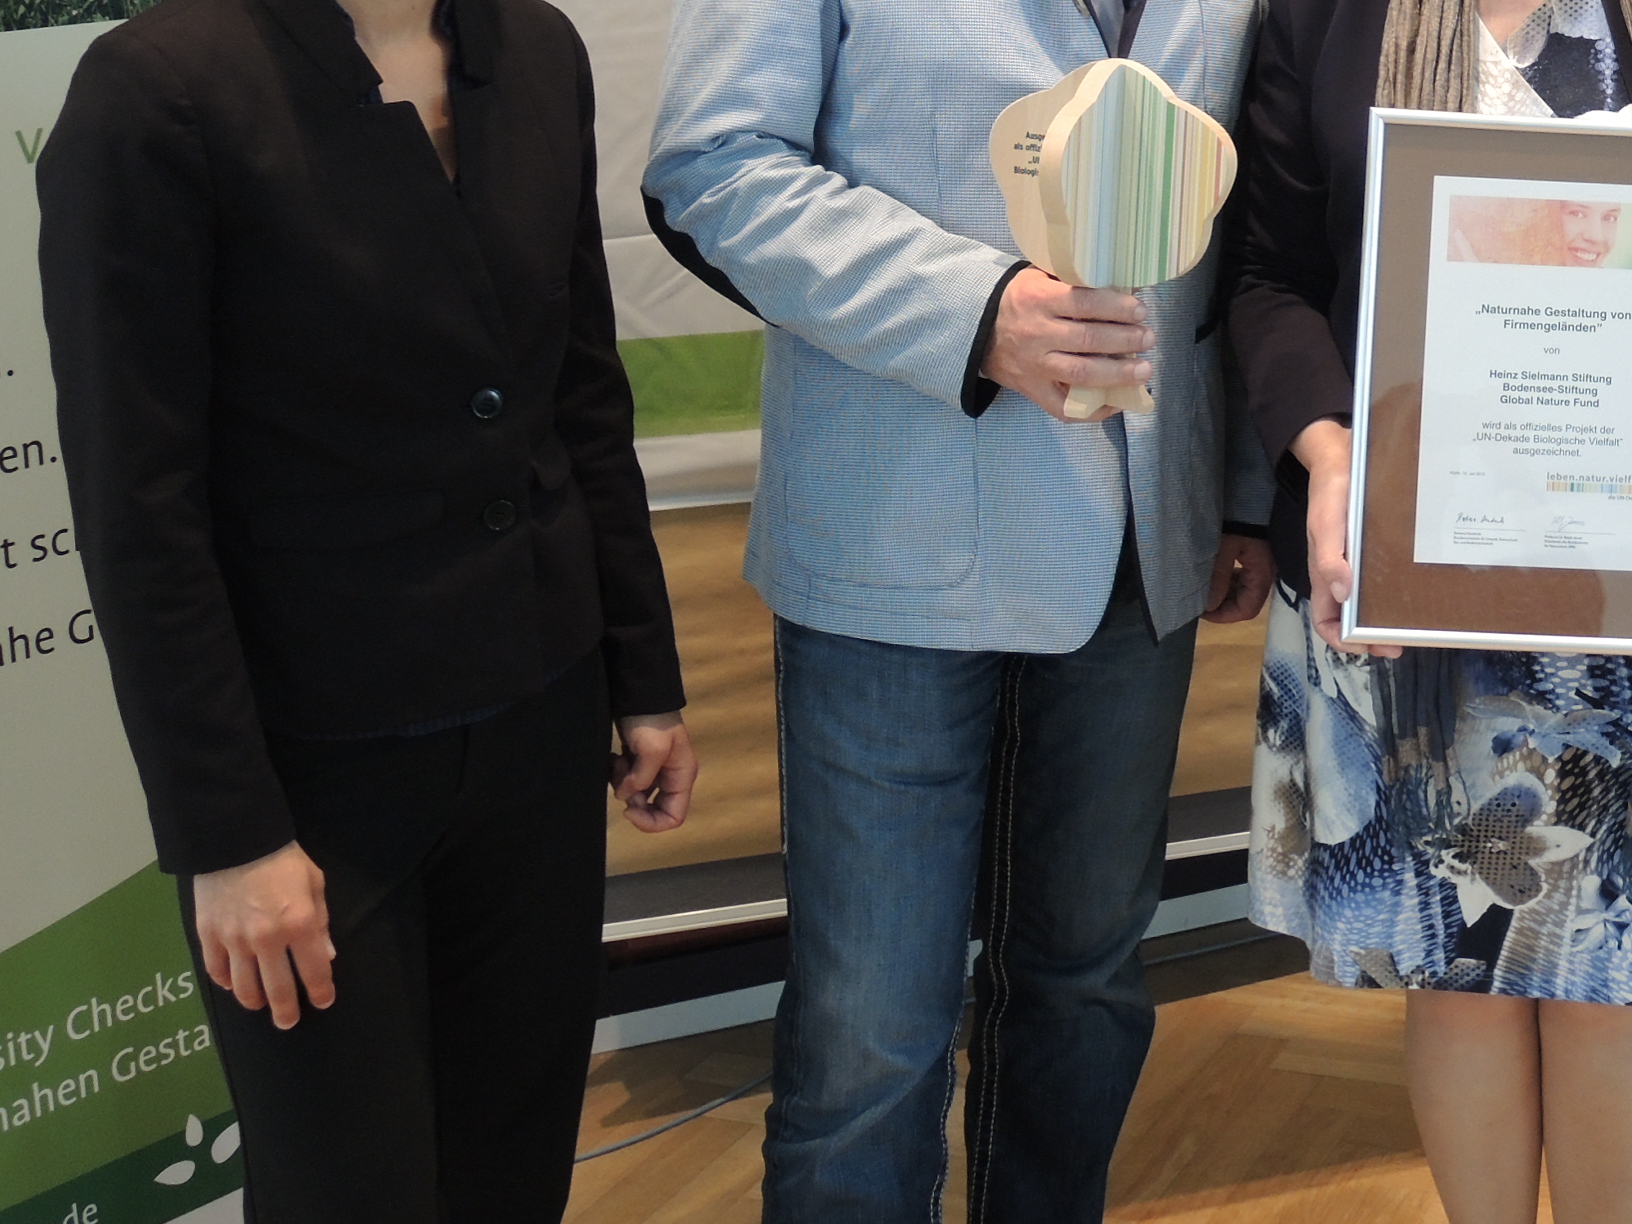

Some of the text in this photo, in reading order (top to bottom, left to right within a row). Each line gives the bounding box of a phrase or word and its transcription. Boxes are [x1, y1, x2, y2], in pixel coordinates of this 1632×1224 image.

[1544, 307, 1607, 321] Gestaltung
[1610, 311, 1632, 320] von
[1543, 347, 1560, 355] von
[1489, 370, 1612, 385] Heinz Sielmann Stiftung
[1502, 382, 1598, 397] Bodensee-Stiftung
[1500, 395, 1600, 408] Global Nature Fund
[1482, 421, 1615, 435] wird als offizielles Projekt der
[1533, 434, 1586, 446] Biologische
[1512, 446, 1582, 457] ausgezeichnet.
[31, 528, 70, 562] sc
[0, 609, 94, 666] he G
[66, 971, 194, 1040] Checks
[111, 1024, 211, 1083] Gesta
